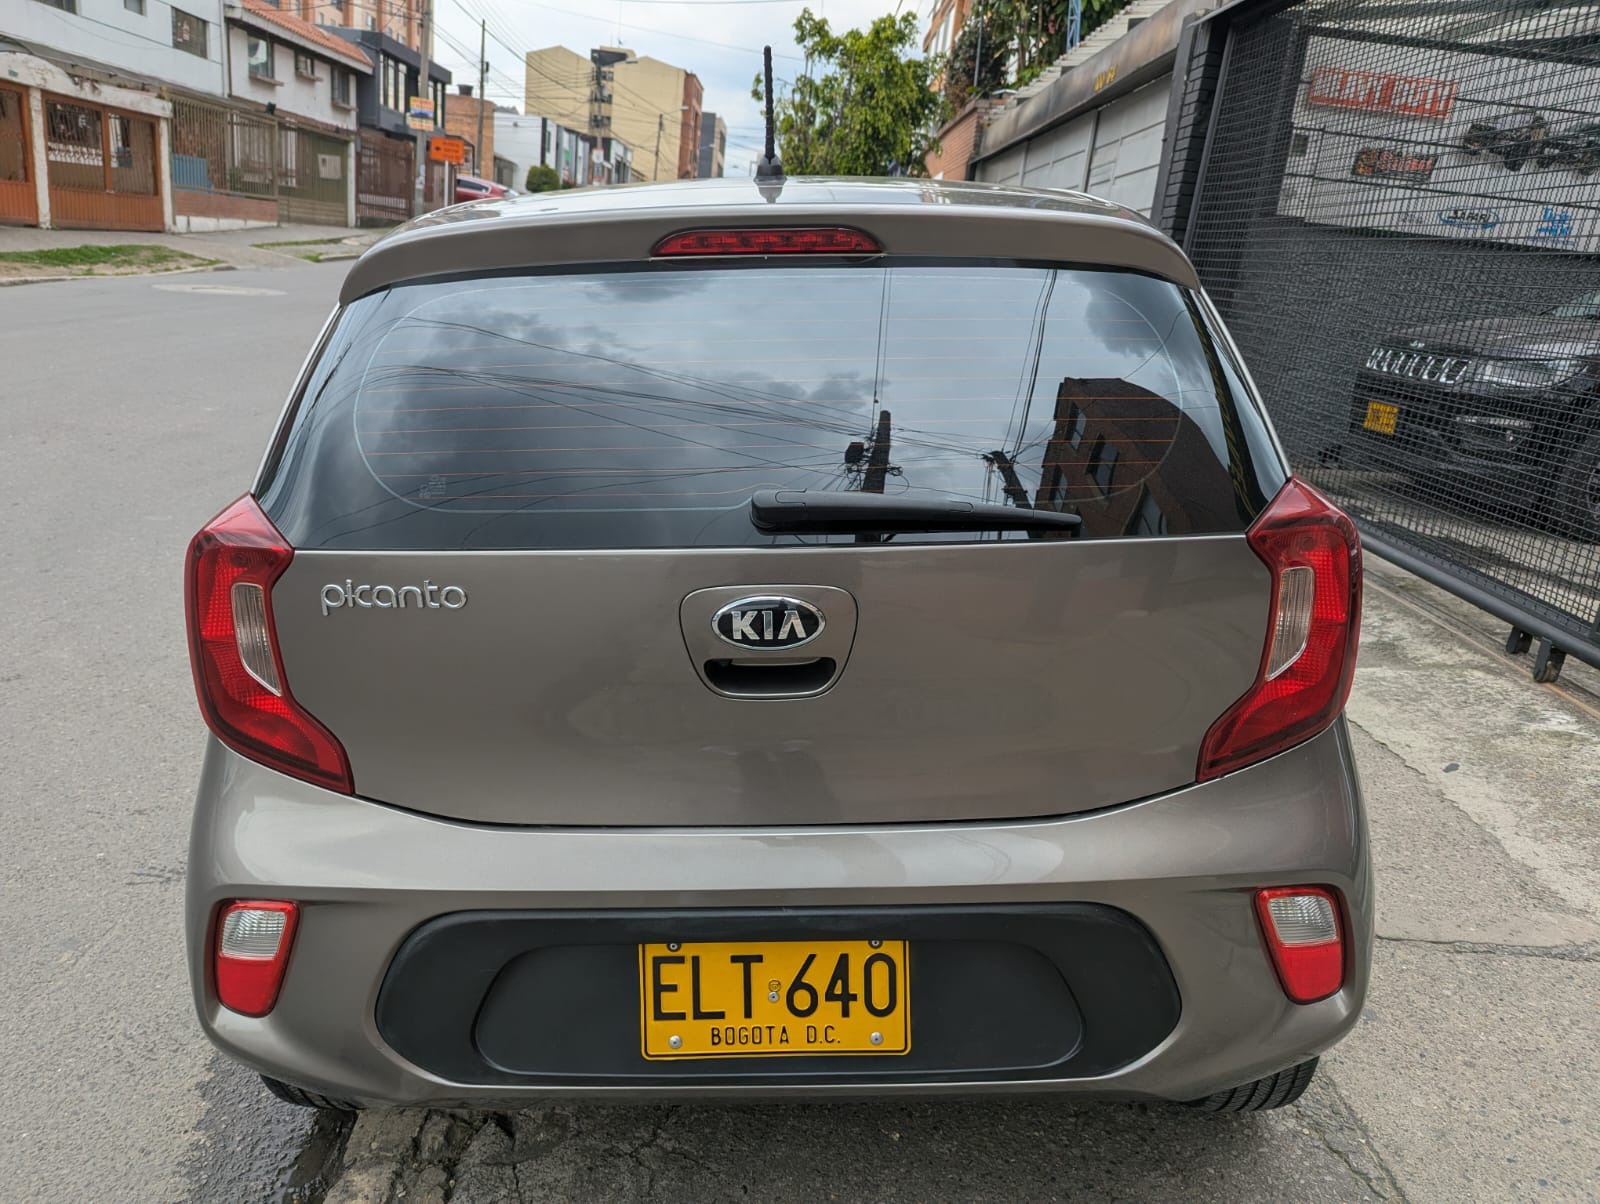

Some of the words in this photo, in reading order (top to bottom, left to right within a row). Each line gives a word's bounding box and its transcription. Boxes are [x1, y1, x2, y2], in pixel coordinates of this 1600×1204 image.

[320, 578, 467, 616] picanto
[731, 610, 807, 640] KIA
[652, 954, 764, 1021] ELT
[786, 952, 897, 1018] 640
[710, 1025, 790, 1046] BOGOTA
[806, 1025, 841, 1044] D.C.
